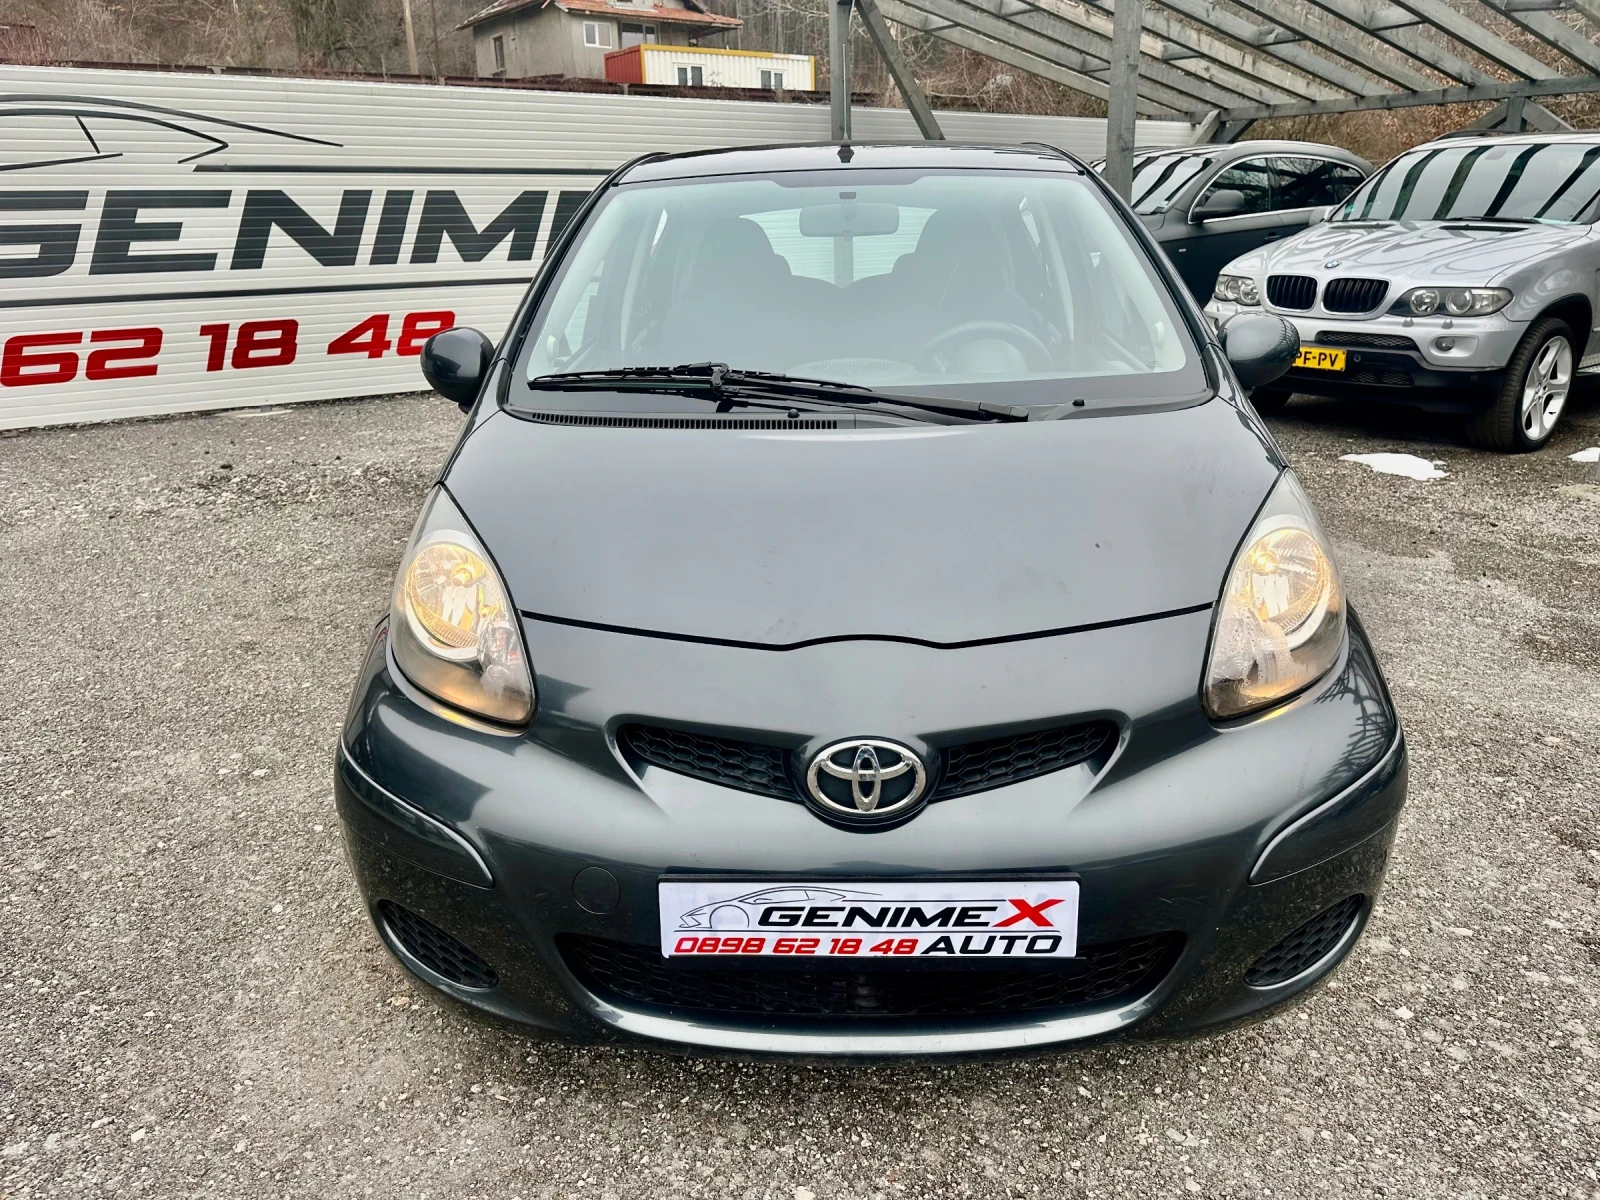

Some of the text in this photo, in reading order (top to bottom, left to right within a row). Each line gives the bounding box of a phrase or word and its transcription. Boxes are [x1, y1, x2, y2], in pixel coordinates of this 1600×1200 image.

[0, 310, 455, 387] 62 18 48
[758, 899, 1065, 927] GENIMEX
[674, 935, 1062, 955] 0898 62 18 48 AUTO
